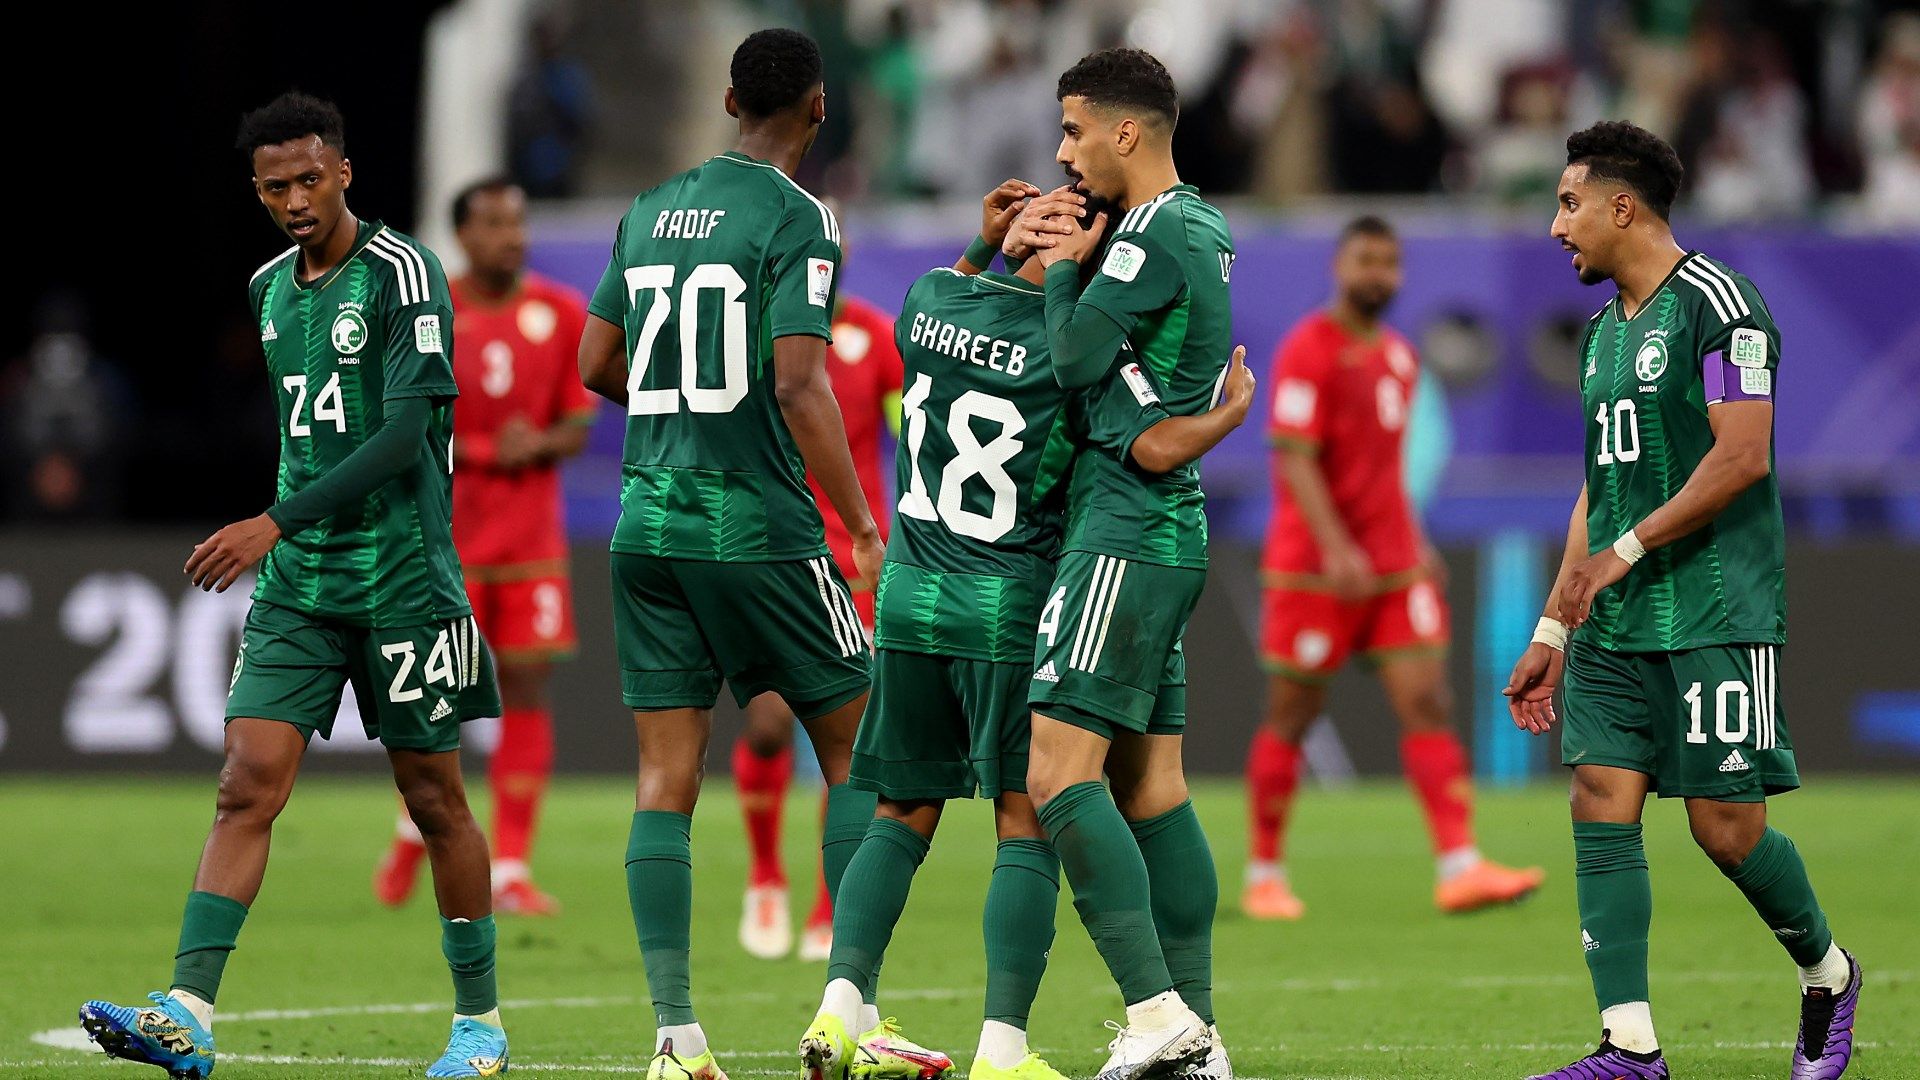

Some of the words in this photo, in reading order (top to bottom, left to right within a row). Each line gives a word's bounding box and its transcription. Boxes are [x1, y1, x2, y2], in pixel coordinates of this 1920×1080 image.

[652, 209, 726, 239] RADIF
[1117, 246, 1131, 255] AFC
[623, 263, 749, 416] 20
[910, 311, 1028, 377] GHAREEB
[1737, 341, 1762, 353] LIVE
[338, 357, 360, 365] SAUDI
[1745, 371, 1768, 380] LIVE
[283, 371, 346, 437] 24
[1638, 385, 1658, 393] SAUDI
[1595, 399, 1641, 465] 10
[898, 371, 1027, 543] 18
[1037, 585, 1067, 647] 4
[381, 629, 456, 703] 24
[1033, 672, 1060, 683] adidas
[429, 706, 453, 722] adidas
[1683, 680, 1750, 744] 10
[1718, 762, 1750, 772] adidas
